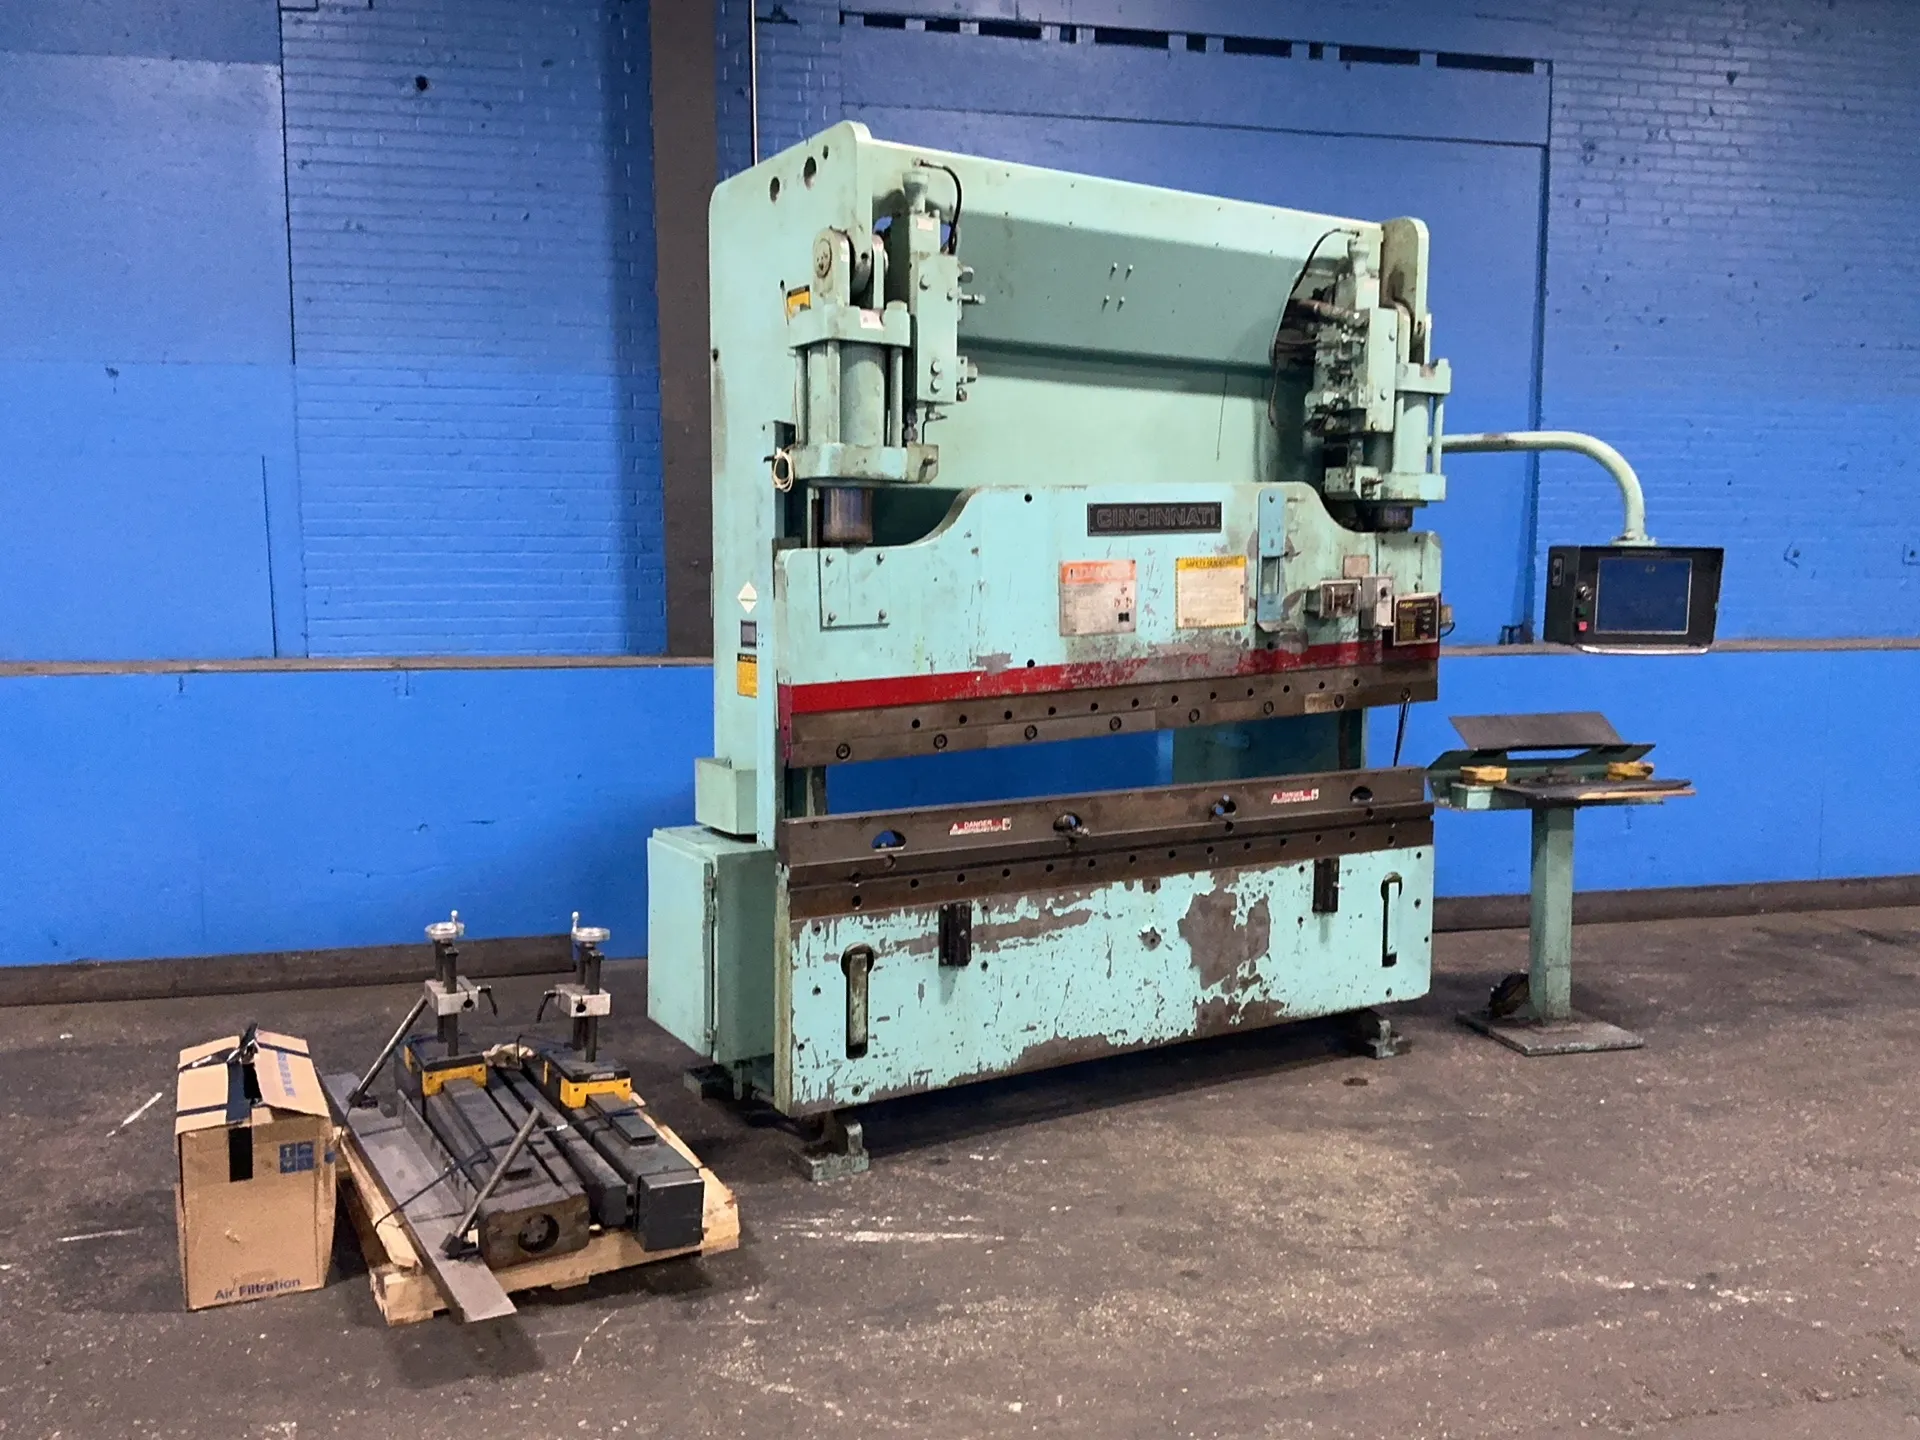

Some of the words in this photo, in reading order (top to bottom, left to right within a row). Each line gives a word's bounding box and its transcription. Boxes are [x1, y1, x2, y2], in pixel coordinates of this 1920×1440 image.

[1097, 507, 1216, 528] CINCINNATI
[964, 819, 992, 830] DANGER
[214, 1288, 233, 1300] Air
[239, 1278, 301, 1297] Filtration
